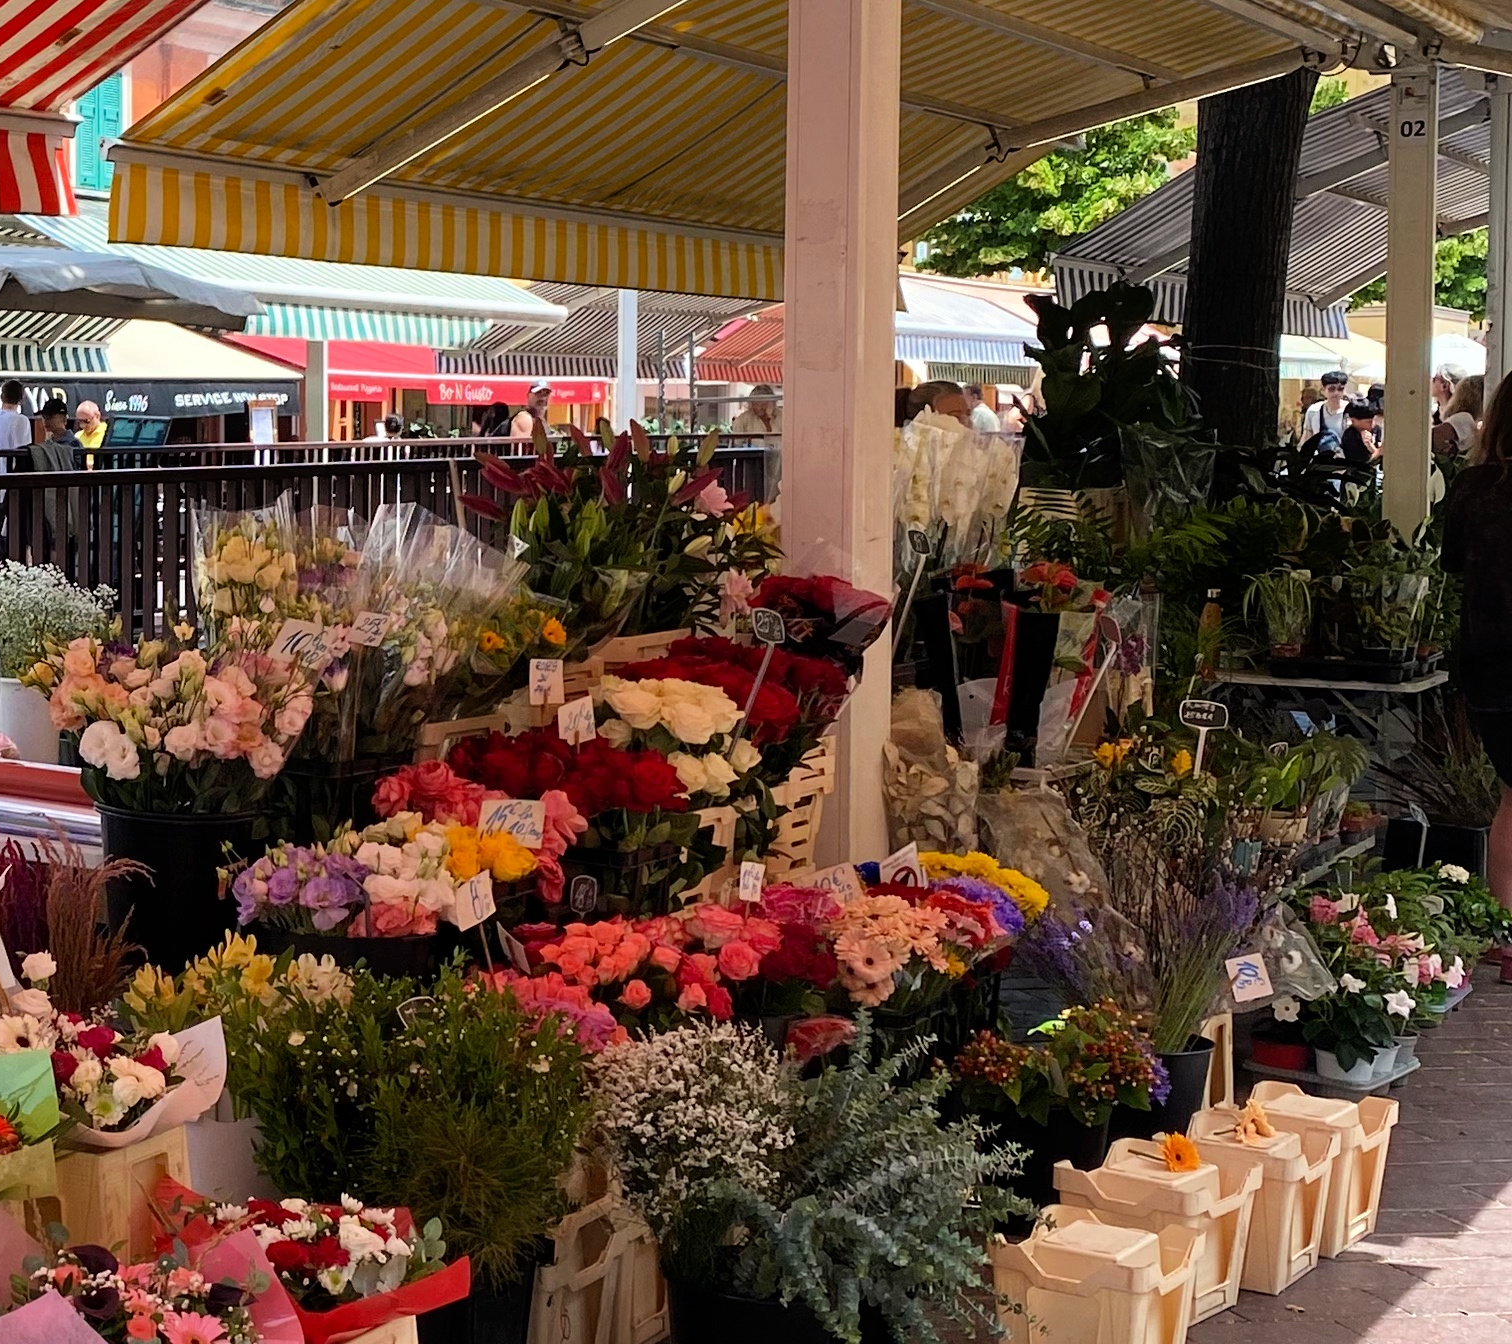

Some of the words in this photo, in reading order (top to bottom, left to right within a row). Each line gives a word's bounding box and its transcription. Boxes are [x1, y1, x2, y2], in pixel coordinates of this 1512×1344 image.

[1400, 119, 1426, 138] 02
[174, 391, 233, 408] SERVICE
[438, 384, 454, 401] Bo
[455, 384, 463, 400] N
[464, 383, 494, 401] Gusto
[104, 390, 128, 413] Since
[128, 393, 149, 413] 1996
